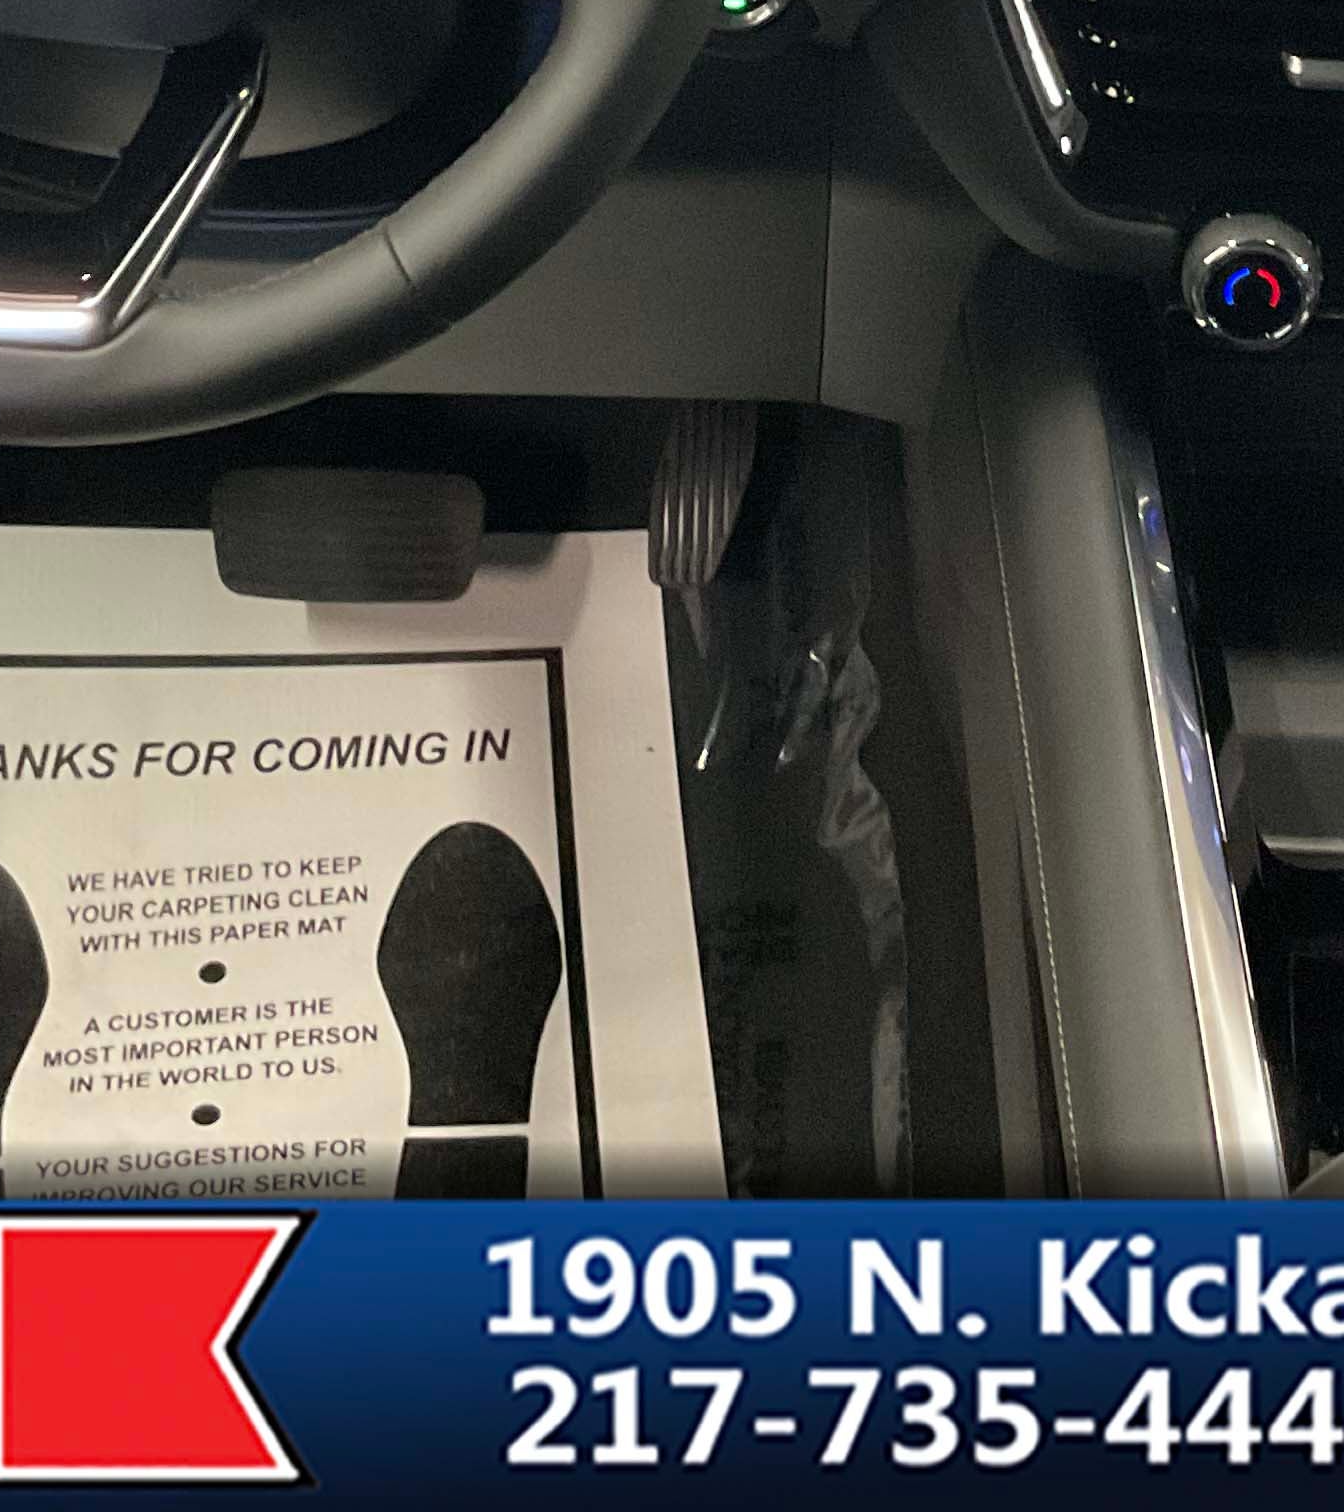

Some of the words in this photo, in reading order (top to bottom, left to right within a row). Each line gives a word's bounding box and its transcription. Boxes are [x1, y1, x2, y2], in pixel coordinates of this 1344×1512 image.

[133, 740, 236, 778] FOR
[253, 731, 449, 774] COMING
[464, 728, 512, 762] IN
[67, 871, 105, 893] WE
[113, 867, 176, 889] HAVE
[184, 862, 253, 885] TRIED
[260, 860, 292, 879] TO
[299, 855, 362, 877] KEEP
[66, 902, 134, 925] YOUR
[141, 890, 281, 919] CARPETING
[288, 885, 370, 908] CLEAN
[79, 932, 141, 954] WITH
[148, 926, 203, 949] THIS
[210, 919, 290, 943] PAPER
[297, 916, 348, 935] MAT
[83, 1017, 102, 1036] A
[107, 1006, 248, 1033] CUSTOMER
[256, 1002, 278, 1021] IS
[286, 997, 335, 1018] THE
[42, 1045, 115, 1068] MOST
[122, 1032, 268, 1063] IMPORTANT
[274, 1024, 380, 1049] PERSON
[69, 1076, 94, 1094] IN
[101, 1072, 151, 1091] THE
[159, 1063, 253, 1088] WORLD
[261, 1060, 294, 1080] TO
[301, 1056, 343, 1076] US.
[35, 1156, 110, 1180] YOUR
[117, 1141, 306, 1173] SUGGESTIONS
[314, 1138, 368, 1159] FOR
[188, 1174, 247, 1198] OUR
[255, 1167, 367, 1193] SERVICE
